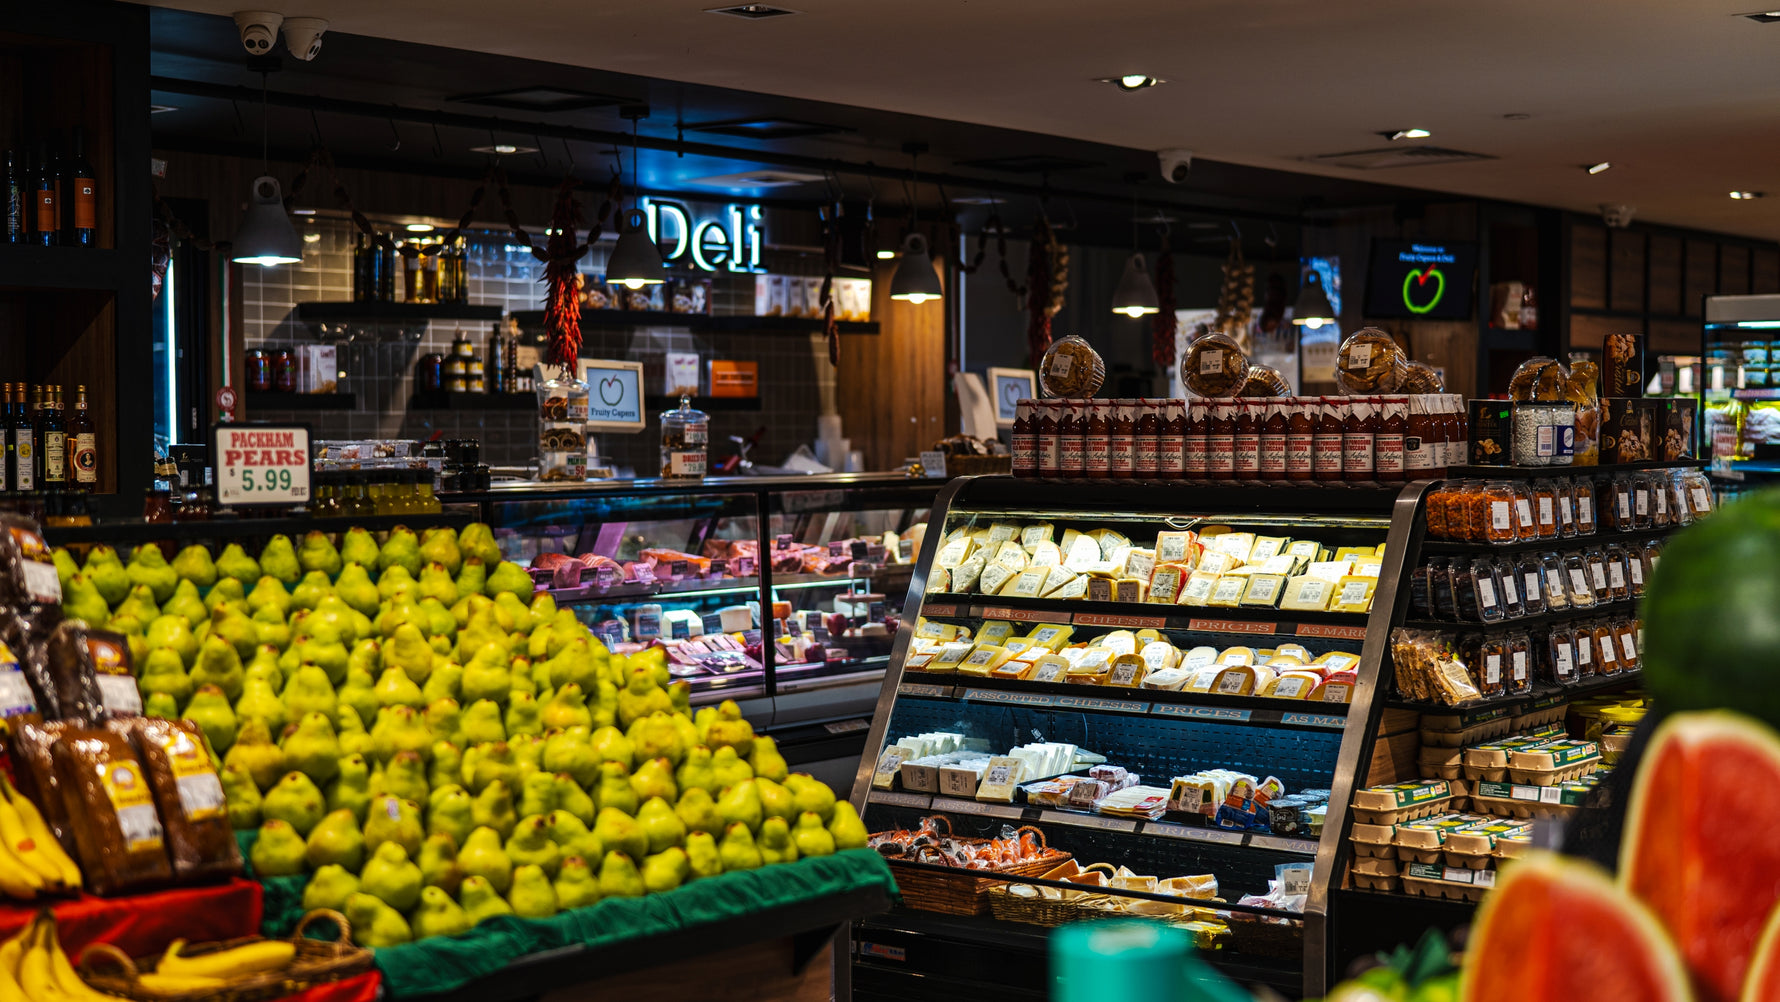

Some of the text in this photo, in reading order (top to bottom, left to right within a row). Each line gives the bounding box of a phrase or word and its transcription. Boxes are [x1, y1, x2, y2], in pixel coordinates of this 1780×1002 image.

[643, 197, 768, 275] Deli
[591, 408, 635, 418] Fruity Capers
[230, 431, 294, 448] PACKHAM
[225, 449, 306, 467] PEARS
[242, 468, 292, 491] 5.99
[1078, 615, 1160, 627] CHEESES
[1195, 620, 1270, 632] PRICES
[1300, 625, 1320, 634] AS
[968, 690, 1050, 704] ASSORTED
[1059, 697, 1142, 710] CHEESES
[1159, 705, 1242, 718] PRICES
[1286, 714, 1308, 723] AS
